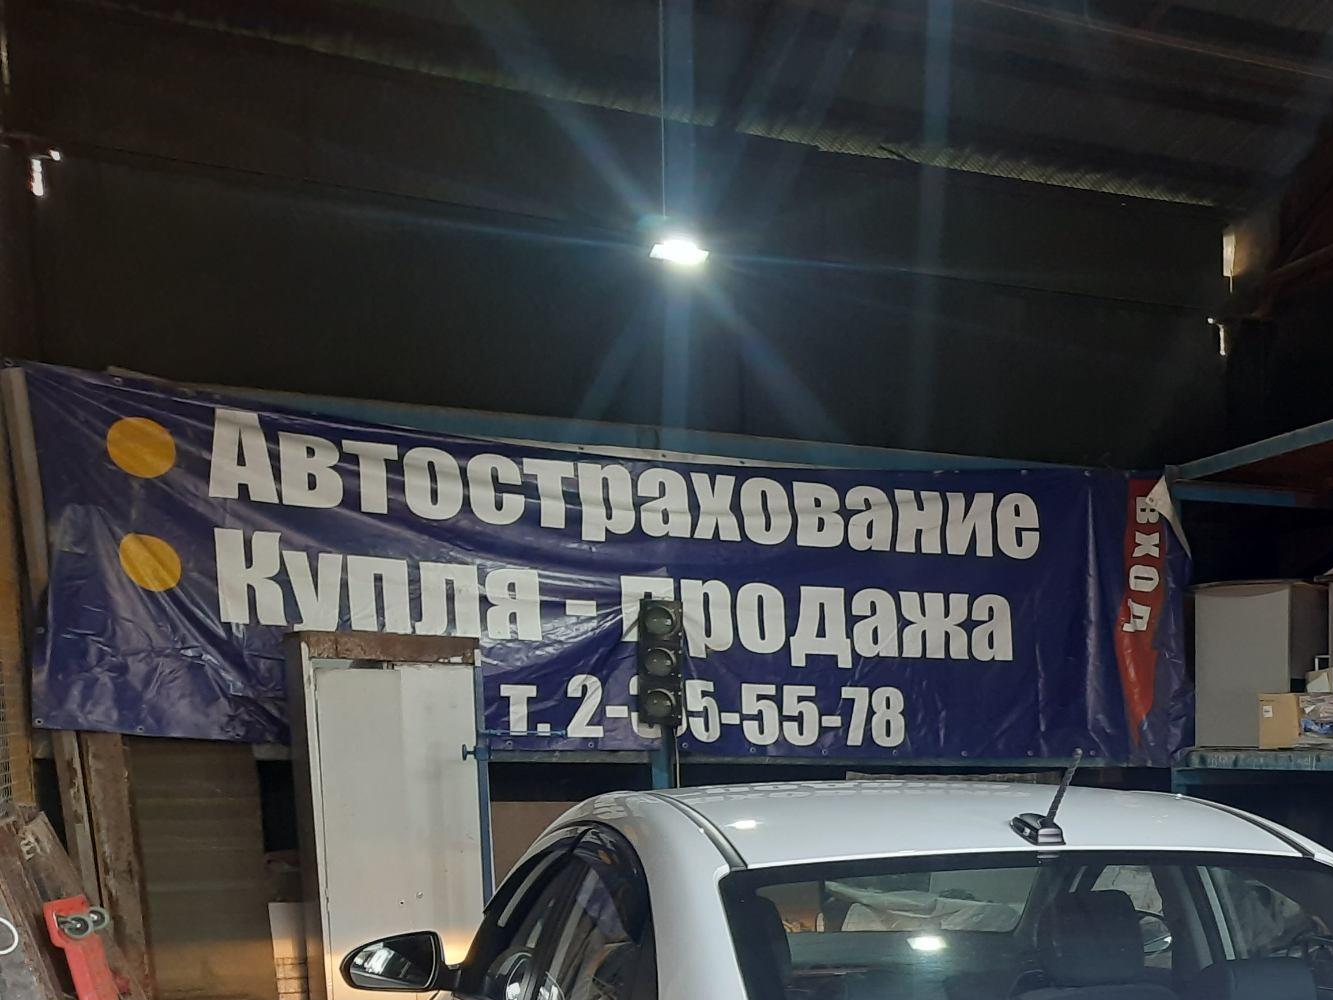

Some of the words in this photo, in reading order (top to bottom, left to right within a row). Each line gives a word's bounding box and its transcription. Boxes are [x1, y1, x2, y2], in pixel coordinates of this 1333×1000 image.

[208, 408, 1040, 560] Автострахование
[213, 526, 543, 641] Купля
[620, 575, 1013, 668] продажа
[1122, 496, 1160, 632] ВХОД
